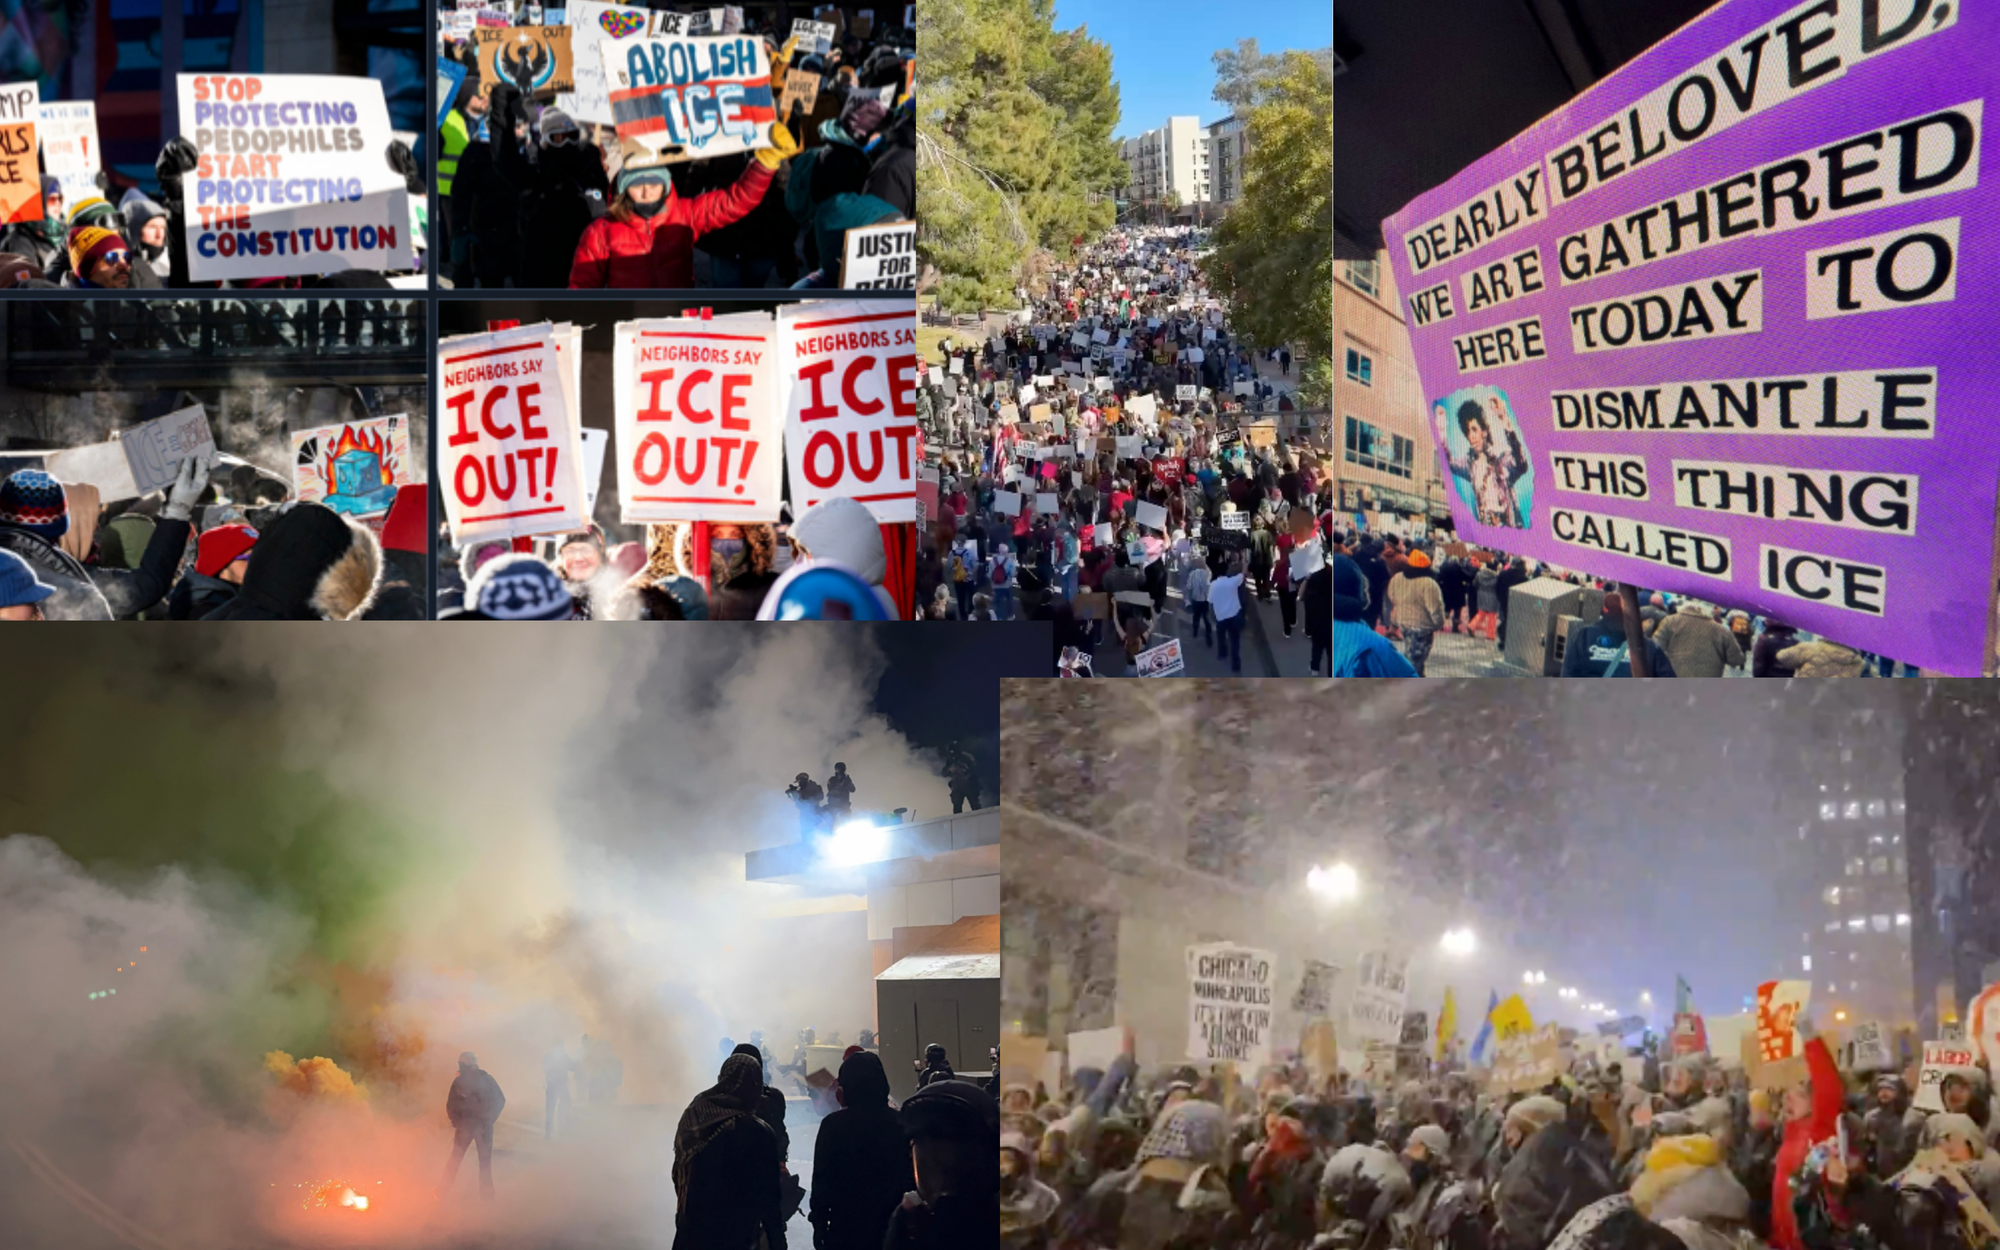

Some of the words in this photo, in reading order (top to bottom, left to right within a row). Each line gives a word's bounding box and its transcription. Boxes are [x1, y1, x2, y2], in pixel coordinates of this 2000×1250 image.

[482, 30, 504, 43] ICE
[542, 27, 567, 39] OUT
[661, 13, 683, 35] ICE
[627, 38, 757, 88] ABOLISH
[193, 77, 262, 101] STOP
[195, 102, 357, 128] PROTECTING
[661, 83, 757, 149] ICE
[1407, 168, 1541, 271] DEARLY
[1552, 0, 1953, 199] BELOVED,
[196, 128, 364, 154] PEDOPHILES
[197, 154, 281, 179] START
[198, 178, 363, 204] PROTECTING
[198, 205, 252, 231] THE
[1408, 284, 1452, 326] WE
[1469, 250, 1542, 310] ARE
[1559, 110, 1974, 280] GATHERED
[197, 226, 396, 258] CONSTITUTION
[878, 257, 911, 277] FOR
[1454, 322, 1544, 371] HERE
[1572, 275, 1758, 348] TODAY
[1818, 233, 1953, 310] TO
[640, 346, 730, 364] NEIGHBORS
[733, 349, 763, 365] SAY
[795, 330, 891, 357] NEIGHBORS
[444, 362, 518, 388] NEIGHBORS
[522, 358, 544, 375] SAY
[798, 354, 916, 422] ICE
[446, 383, 548, 447] ICE
[636, 368, 753, 431] ICE
[1552, 374, 1933, 430] DISMANTLE
[453, 447, 558, 507] OUT!
[632, 431, 760, 495] OUT!
[803, 426, 916, 489] OUT
[1554, 457, 1647, 497] THIS
[1678, 469, 1910, 530] THING
[1553, 511, 1729, 575] CALLED
[1767, 550, 1881, 612] ICE
[1199, 955, 1268, 983] CHICAGO
